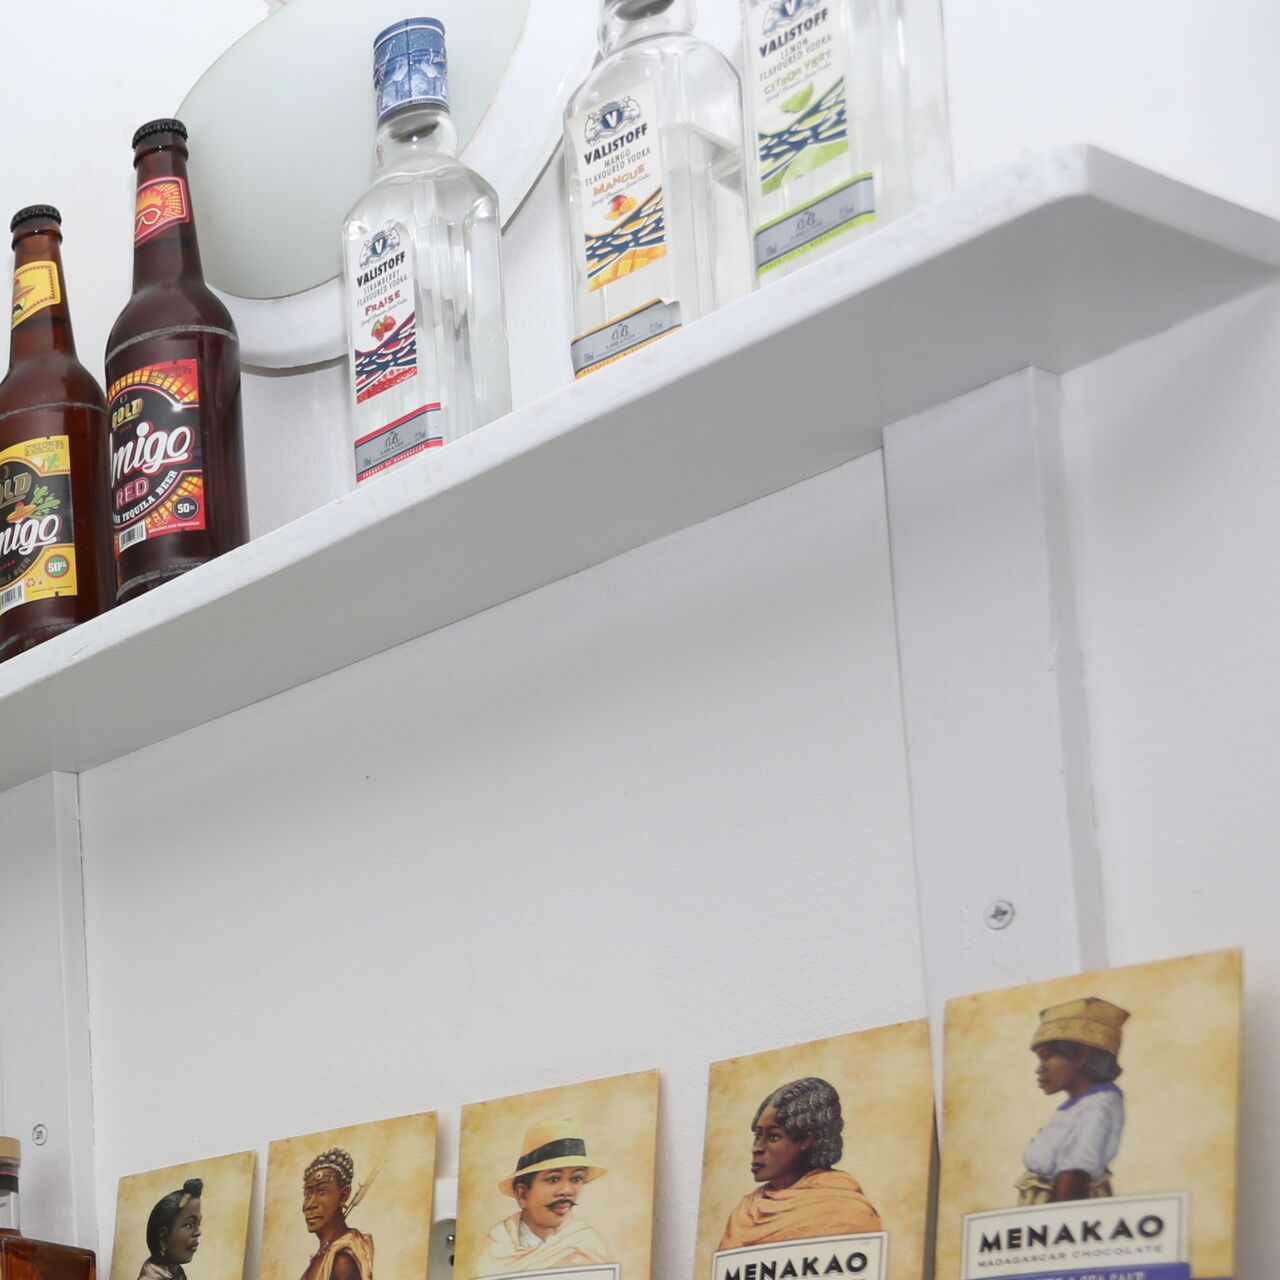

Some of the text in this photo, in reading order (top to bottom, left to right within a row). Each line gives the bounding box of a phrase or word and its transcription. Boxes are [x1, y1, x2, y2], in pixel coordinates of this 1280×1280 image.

[759, 8, 828, 58] VALISTOFF
[781, 38, 807, 60] LEMON
[760, 34, 831, 81] FLAVOURED VODKA
[605, 111, 617, 128] V
[584, 123, 647, 165] VALISTOFF
[604, 149, 630, 168] MANGO
[585, 147, 651, 187] FLAVOURED VODKA
[357, 252, 405, 287] VALISTOFF
[363, 270, 400, 295] STRAWBERRY
[357, 274, 407, 307] FLAVOURED VODKA
[365, 290, 400, 316] FRAISE
[111, 398, 144, 429] GOLD
[116, 479, 149, 510] RED
[122, 495, 155, 521] TEQUILA
[155, 470, 178, 497] BEER
[979, 1215, 1165, 1254] MENAKAO
[978, 1245, 1164, 1268] MADAGASCAR CHOCOLATE
